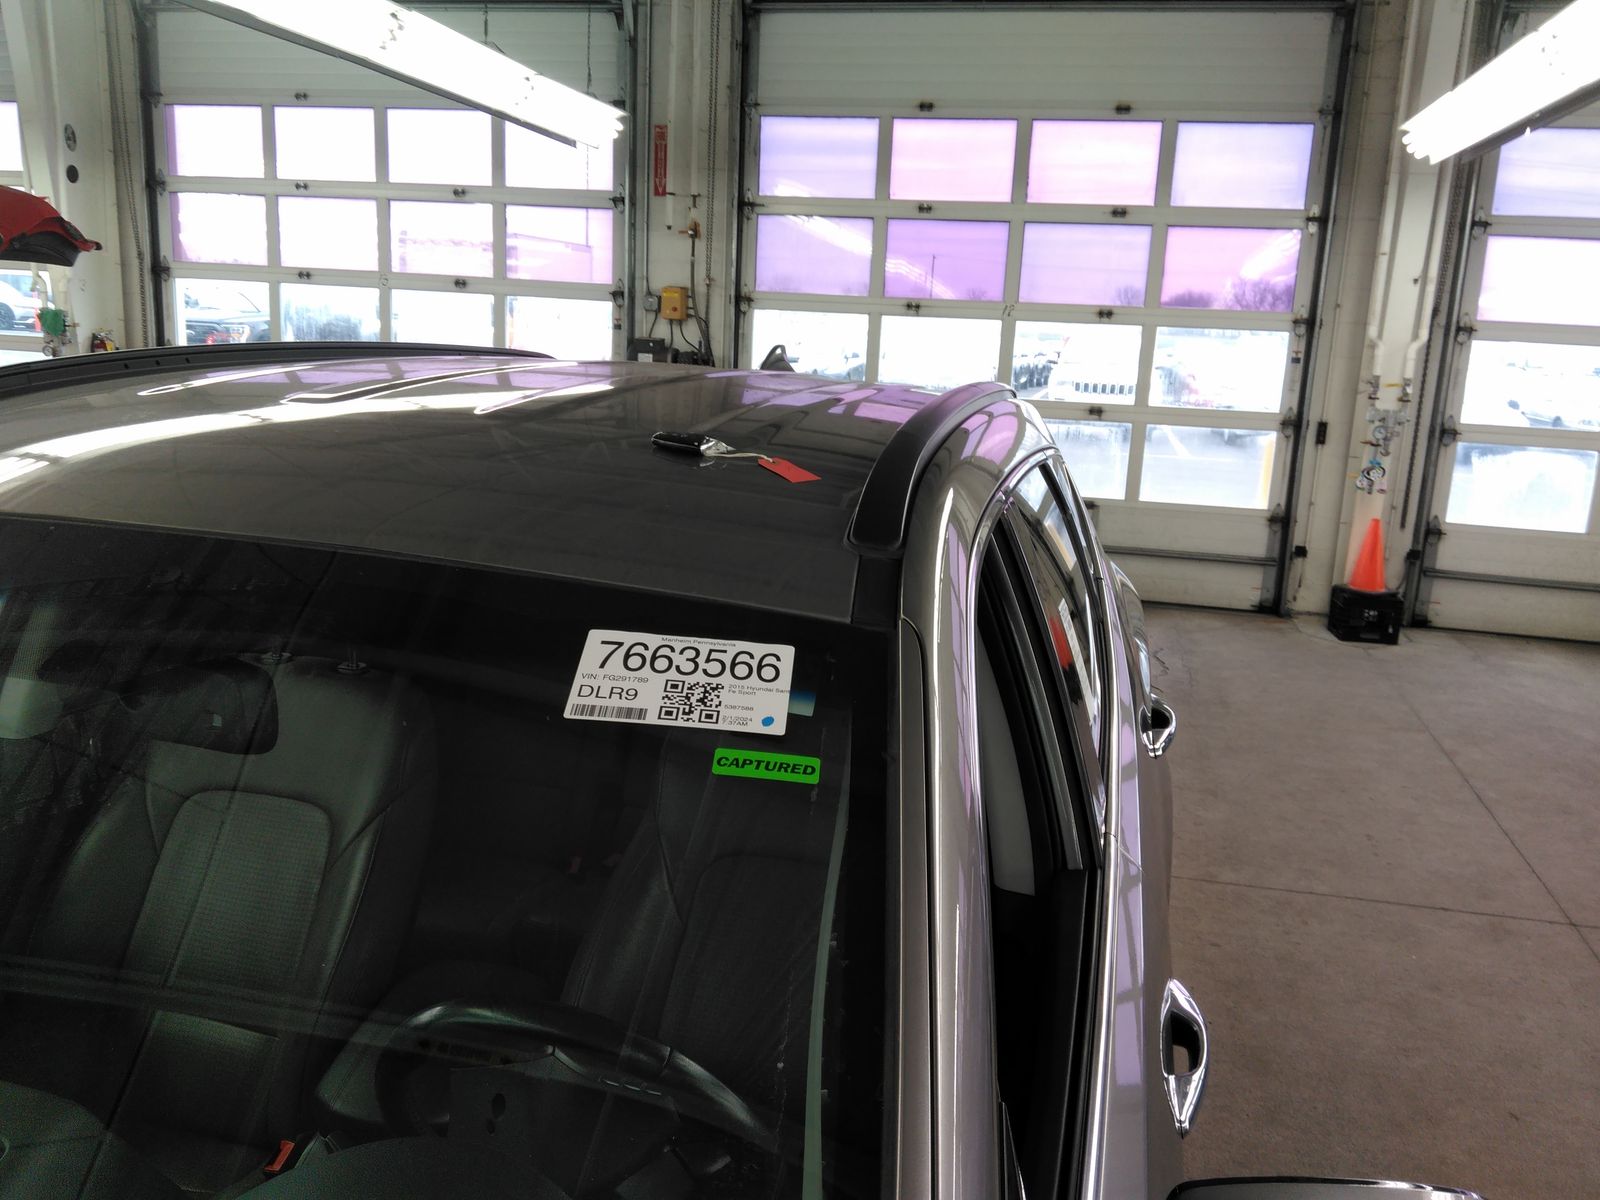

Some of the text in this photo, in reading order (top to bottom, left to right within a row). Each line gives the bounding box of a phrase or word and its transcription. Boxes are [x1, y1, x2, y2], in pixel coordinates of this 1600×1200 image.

[693, 639, 736, 647] Pennsylvania
[598, 640, 782, 683] 7663566
[602, 674, 649, 683] FG291789
[577, 684, 639, 701] DLR9
[716, 756, 816, 777] CAPTURED
